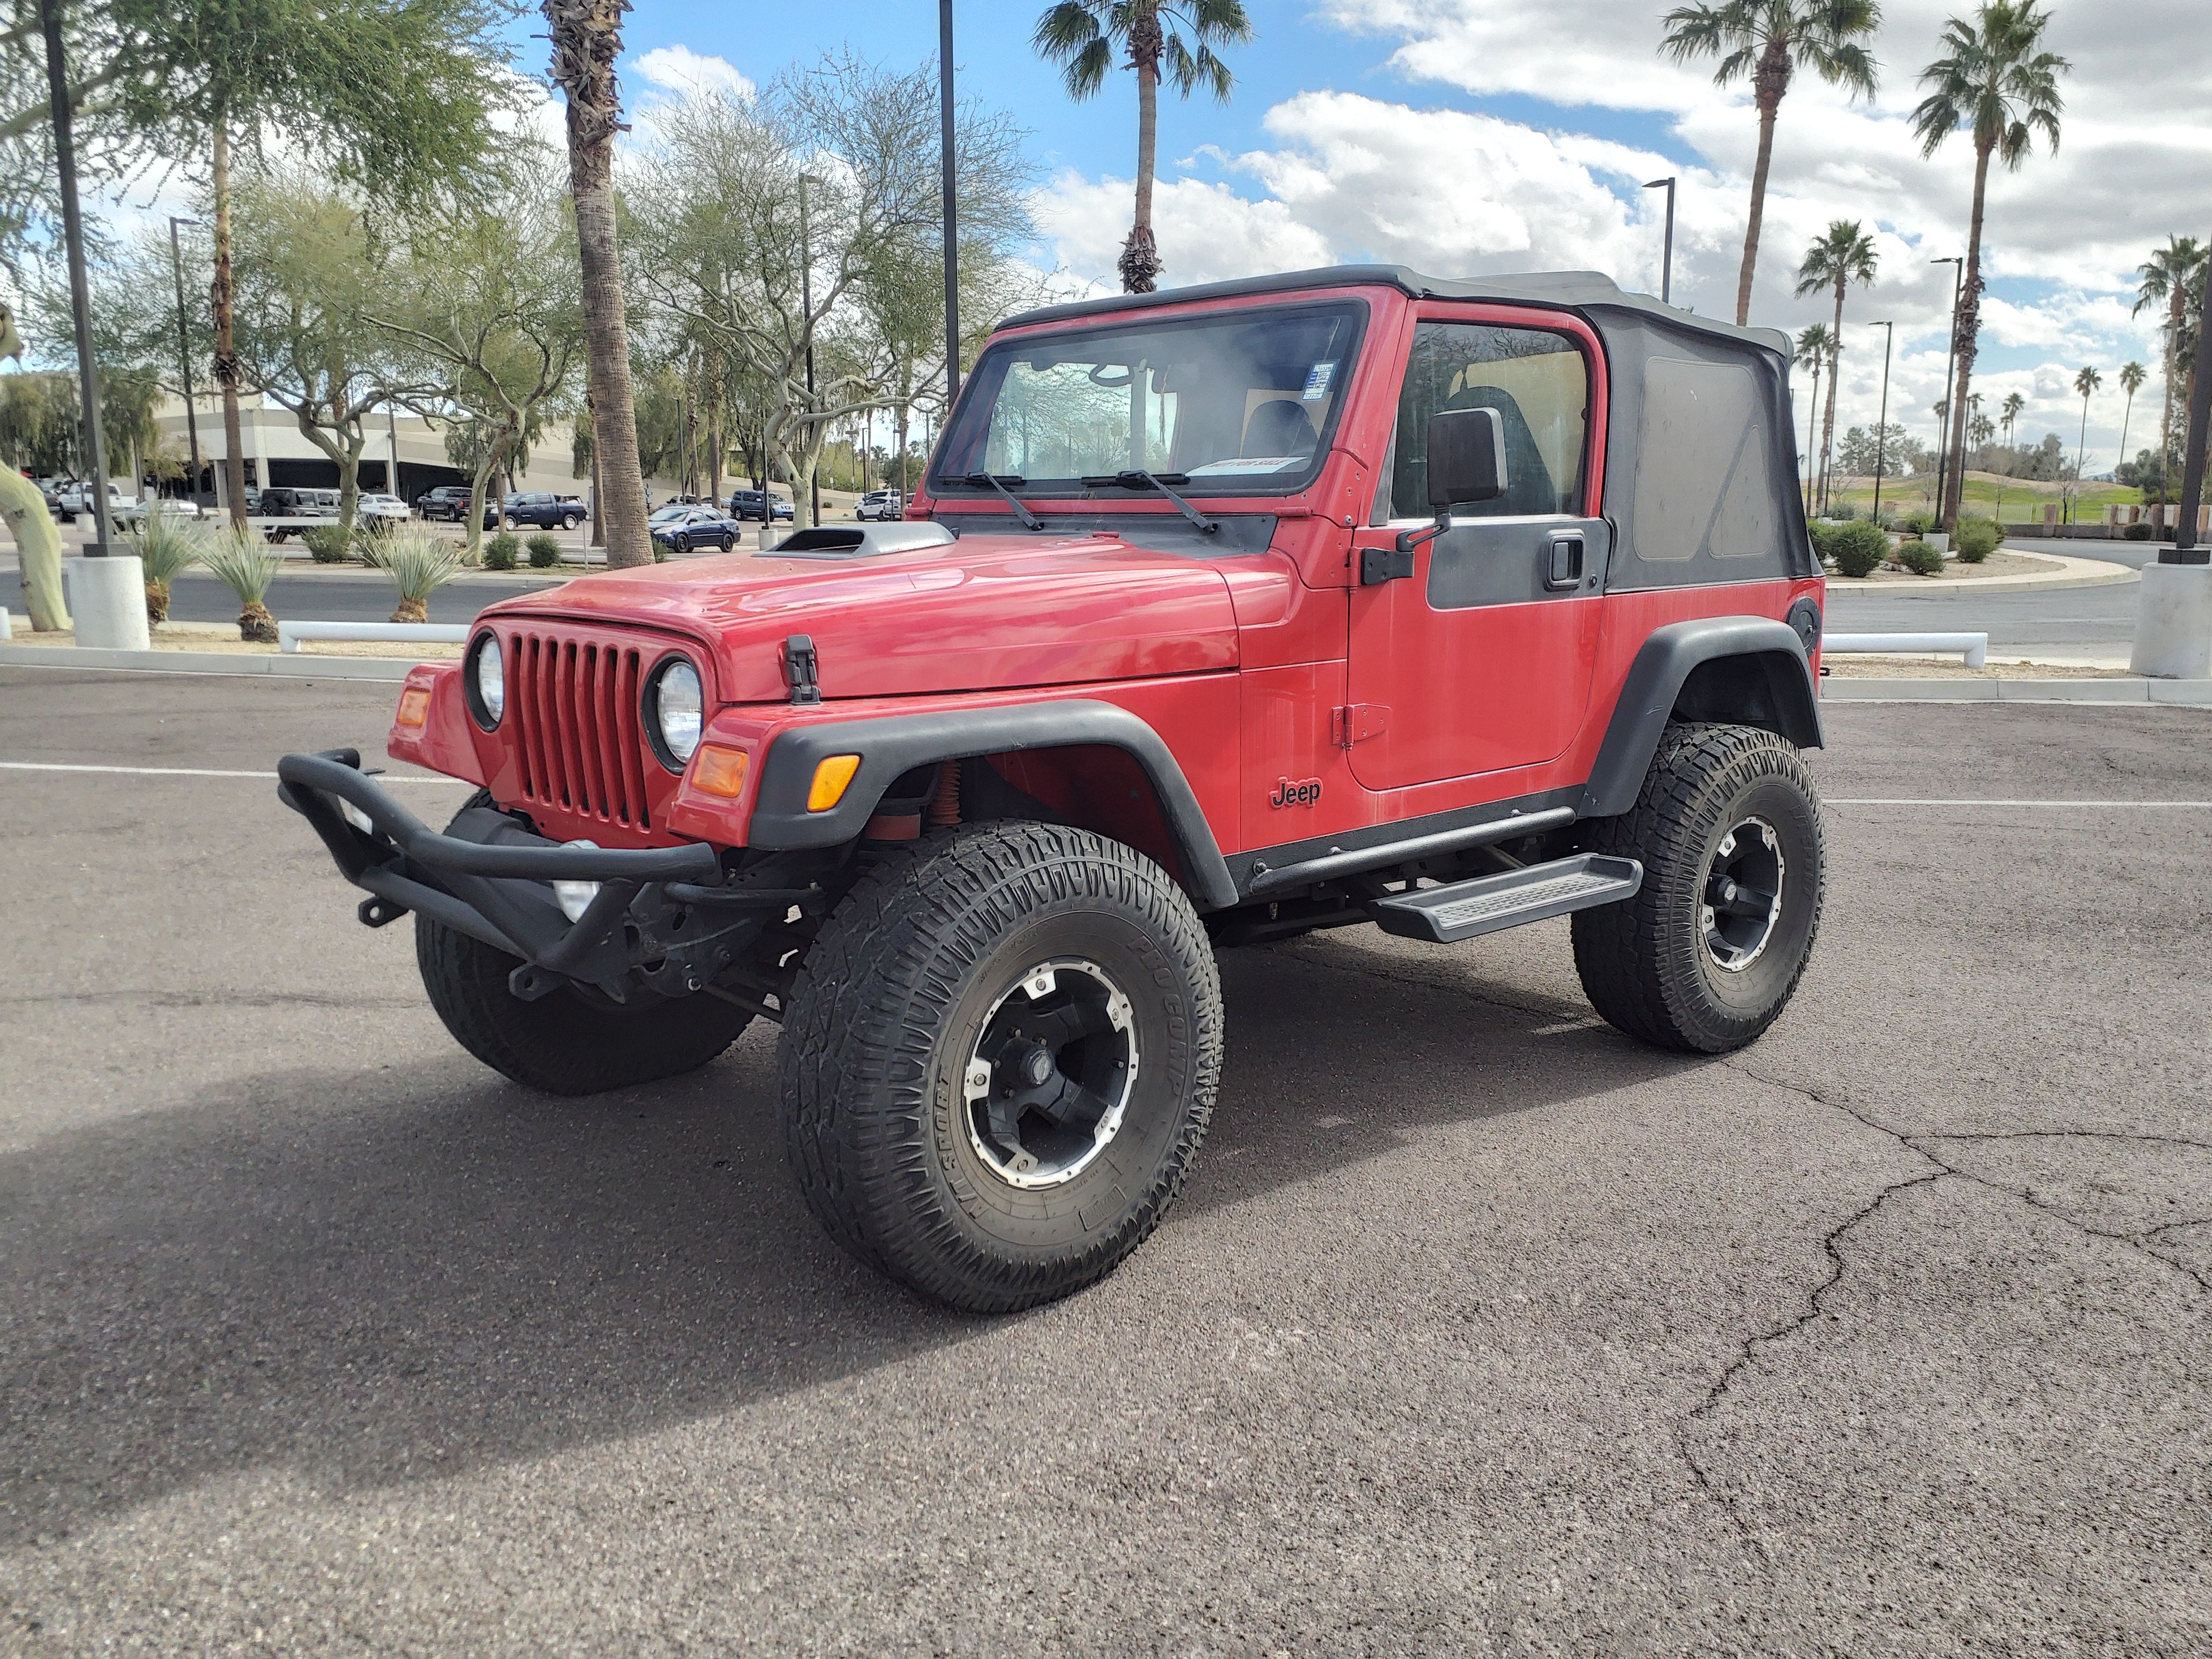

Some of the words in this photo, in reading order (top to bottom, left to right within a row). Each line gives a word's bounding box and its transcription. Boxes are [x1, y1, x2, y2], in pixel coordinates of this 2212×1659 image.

[1273, 783, 1320, 806] Jeep
[1127, 935, 1173, 988] PRO
[1163, 994, 1186, 1096] COMP
[935, 1064, 955, 1171] SPORT
